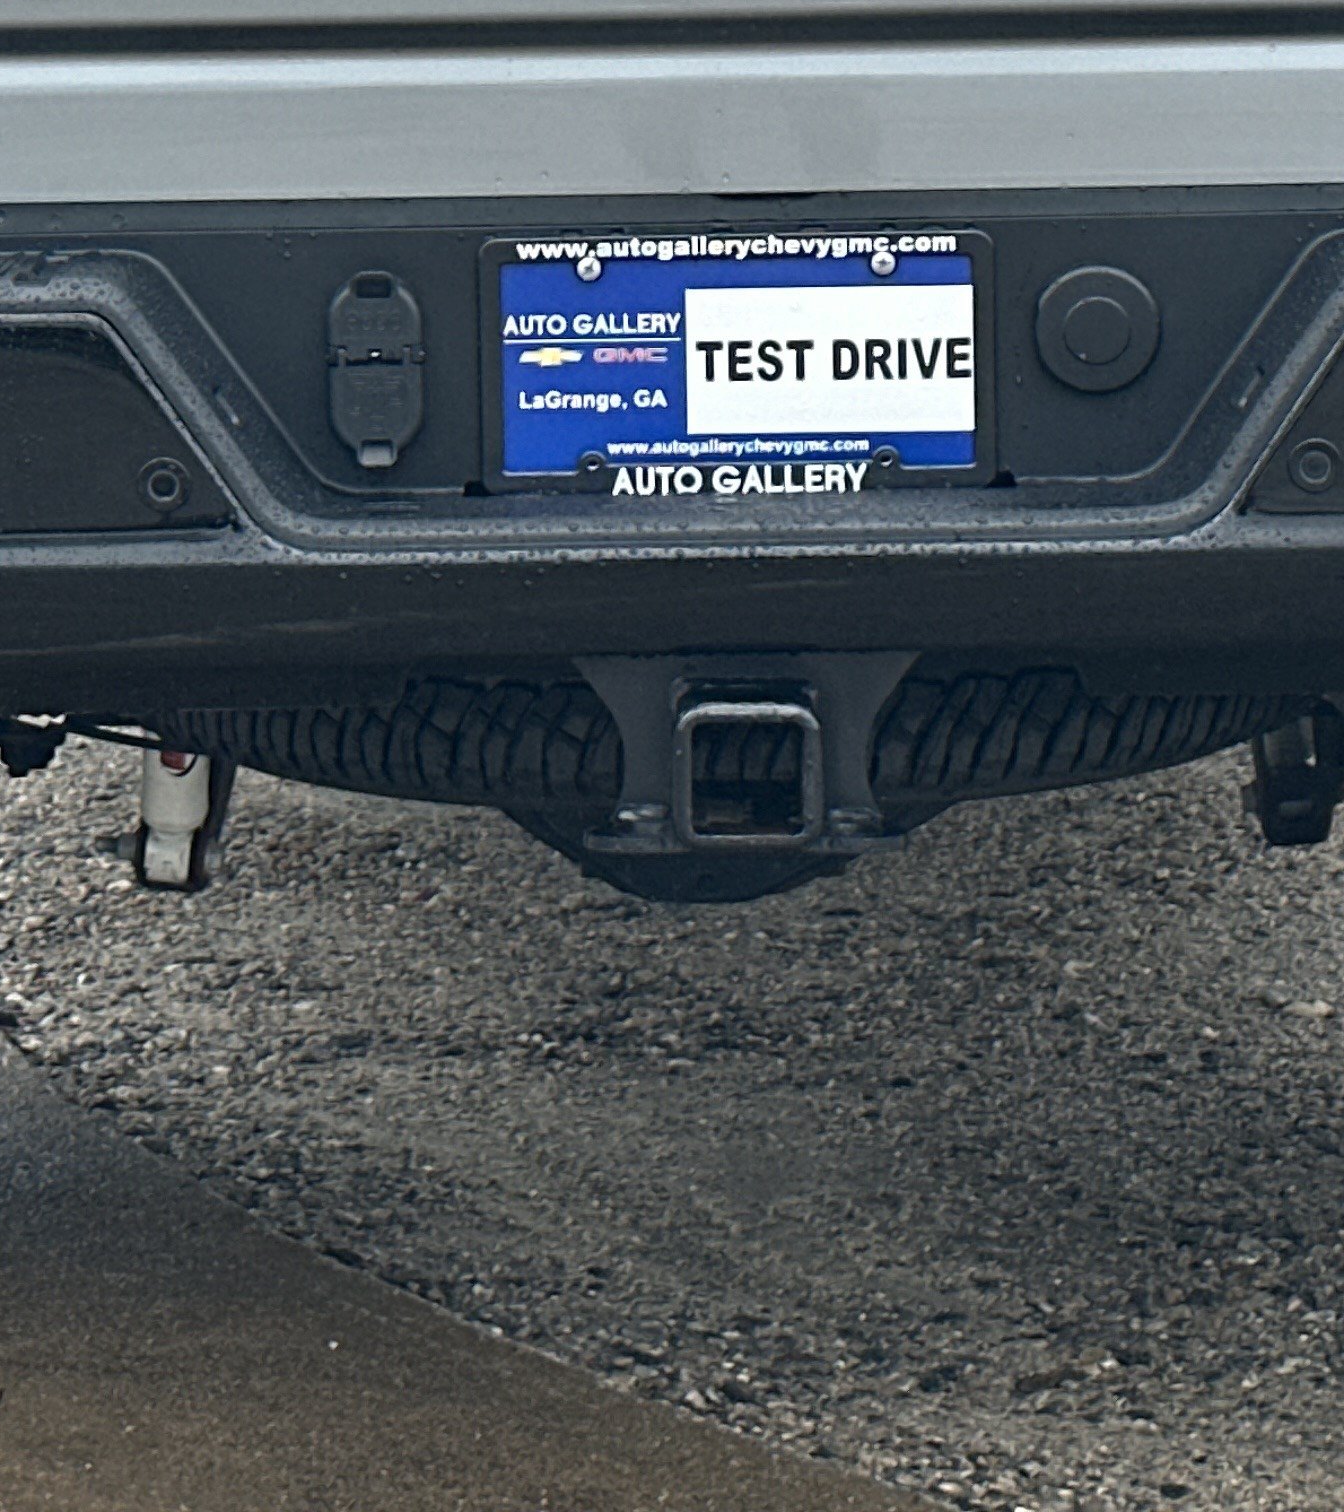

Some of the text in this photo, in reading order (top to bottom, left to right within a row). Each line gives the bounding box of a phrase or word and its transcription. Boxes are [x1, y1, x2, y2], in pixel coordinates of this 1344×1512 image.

[515, 234, 958, 261] www.autogallerychevygmc.com
[502, 312, 682, 337] AUTO GALLERY
[592, 347, 669, 364] GMC
[695, 336, 973, 382] TEST DRIVE
[518, 388, 669, 413] LaGrange, GA
[606, 437, 870, 458] www.autogallerychevygmc.com
[611, 461, 868, 497] AUTO GALLERY
